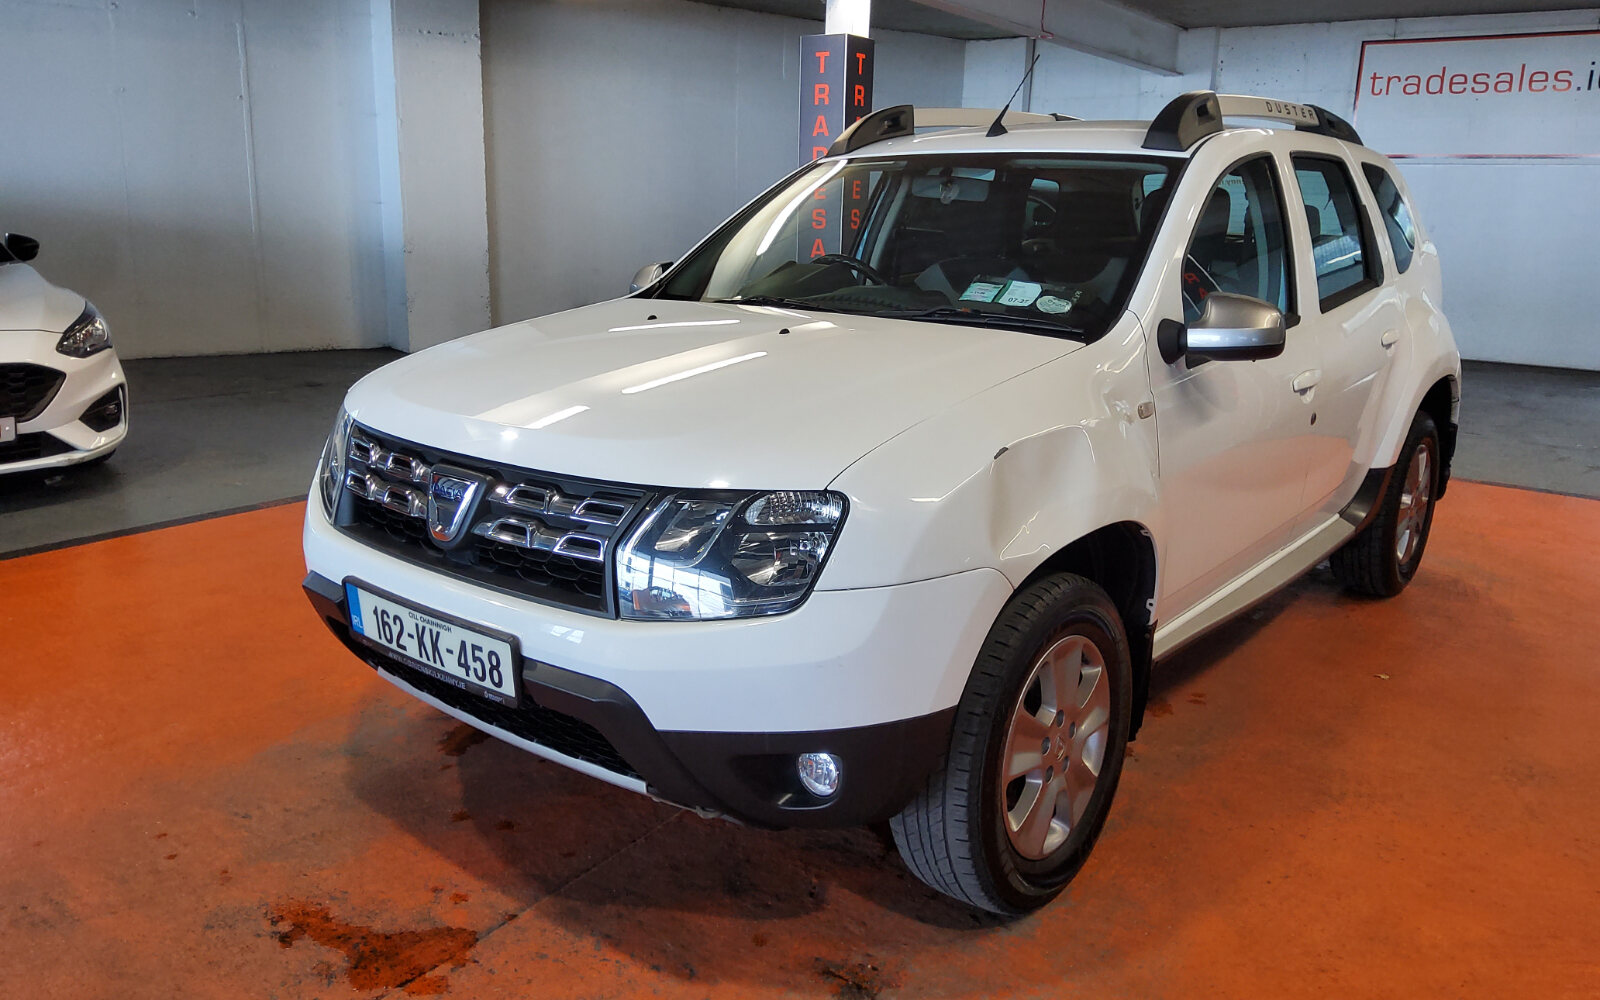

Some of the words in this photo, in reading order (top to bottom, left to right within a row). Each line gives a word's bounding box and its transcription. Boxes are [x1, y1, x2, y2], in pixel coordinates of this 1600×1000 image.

[1370, 61, 1600, 96] tradesales.i
[1265, 101, 1315, 120] DUSTER
[373, 605, 504, 689] 162-KK-458
